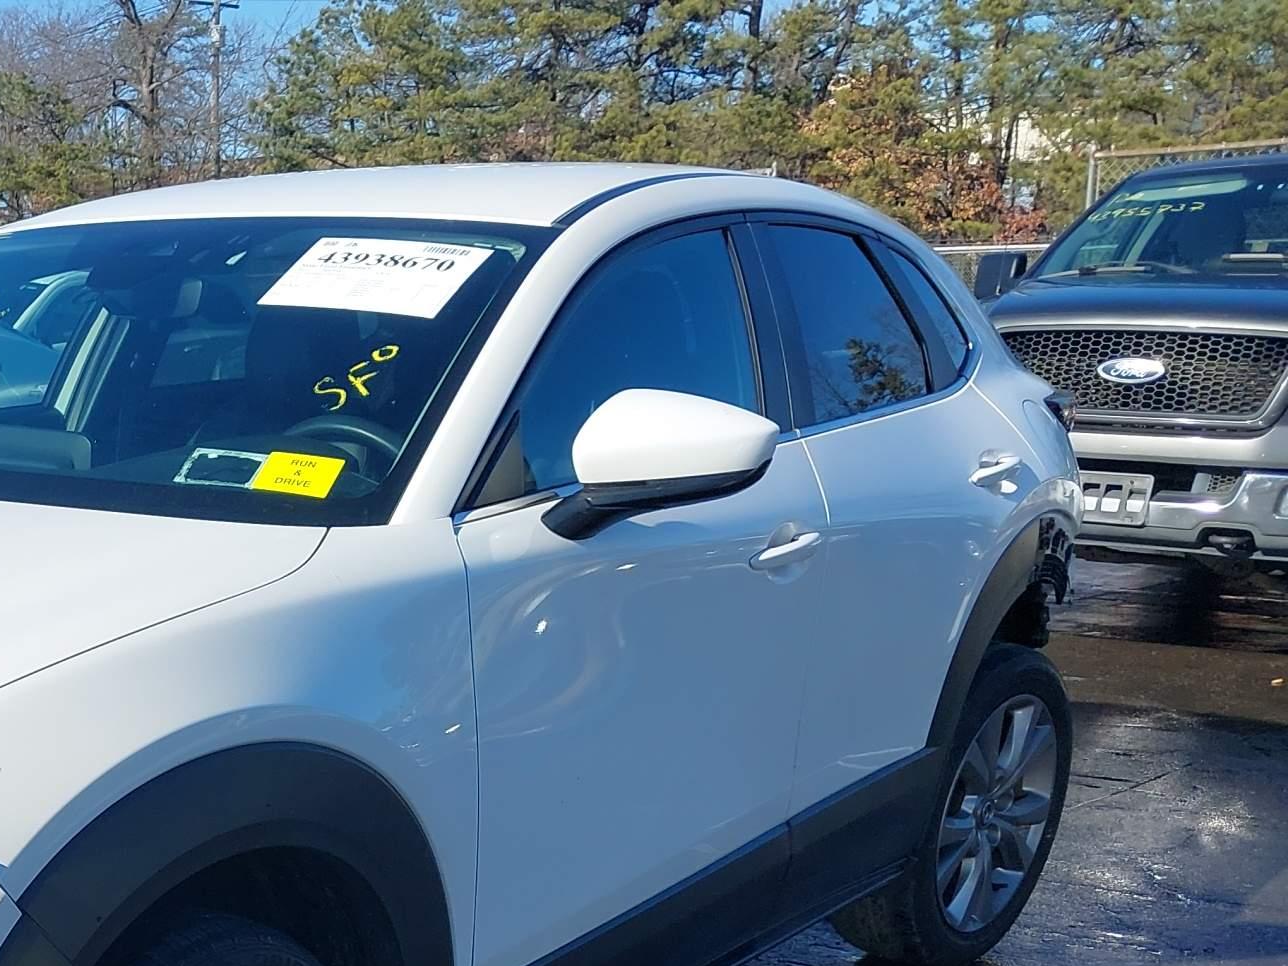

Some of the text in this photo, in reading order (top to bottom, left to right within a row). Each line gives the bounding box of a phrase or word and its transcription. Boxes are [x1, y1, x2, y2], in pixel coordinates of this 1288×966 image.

[318, 251, 456, 273] 43938670
[291, 459, 317, 468] RUN
[274, 477, 312, 488] DRIVE
